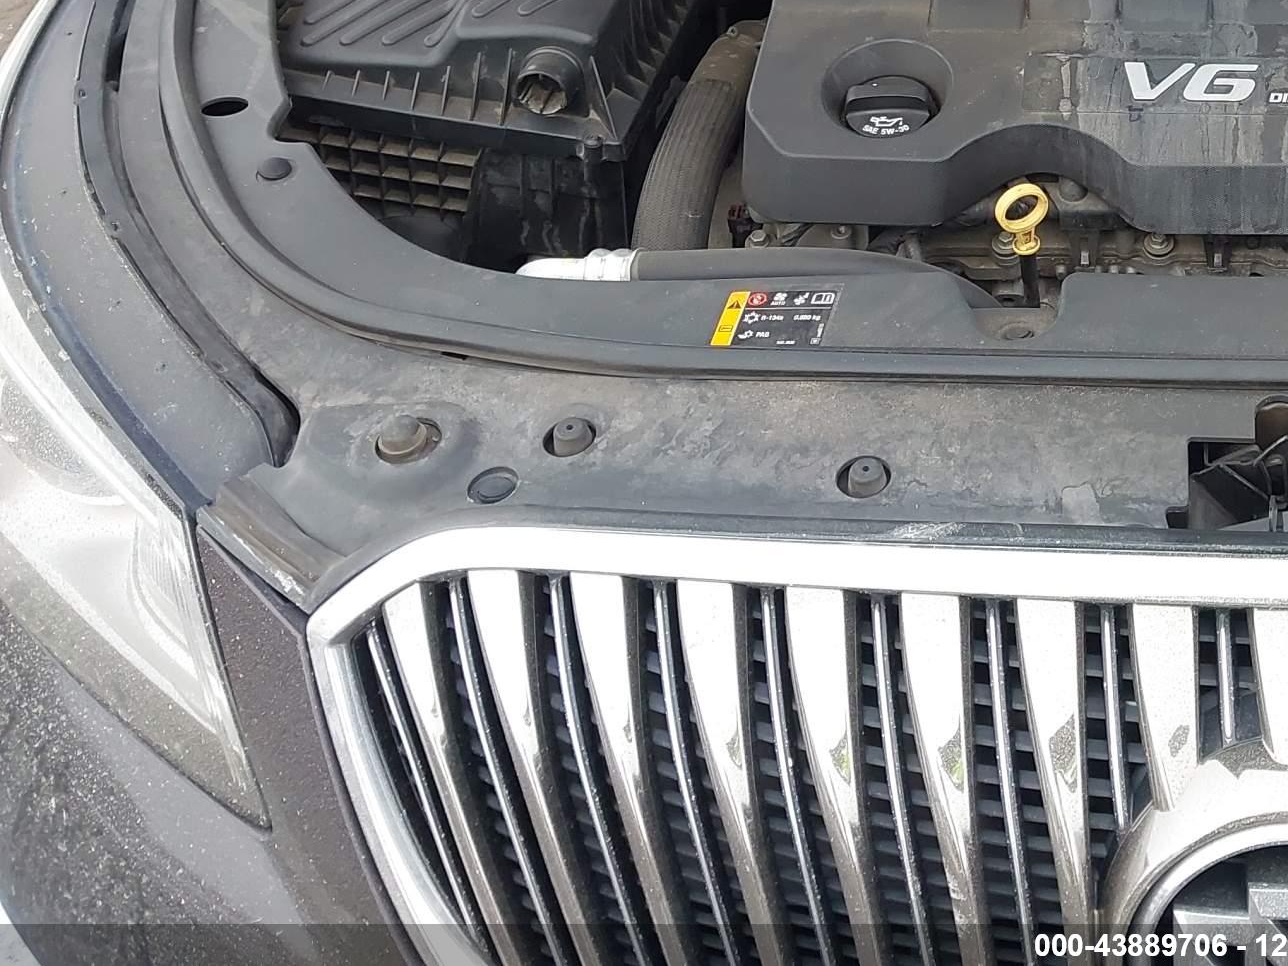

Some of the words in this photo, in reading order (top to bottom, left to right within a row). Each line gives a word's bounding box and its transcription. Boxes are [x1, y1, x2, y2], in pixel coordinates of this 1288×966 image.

[1123, 61, 1260, 102] V6
[862, 124, 879, 134] SAE
[880, 125, 910, 135] 5W-30
